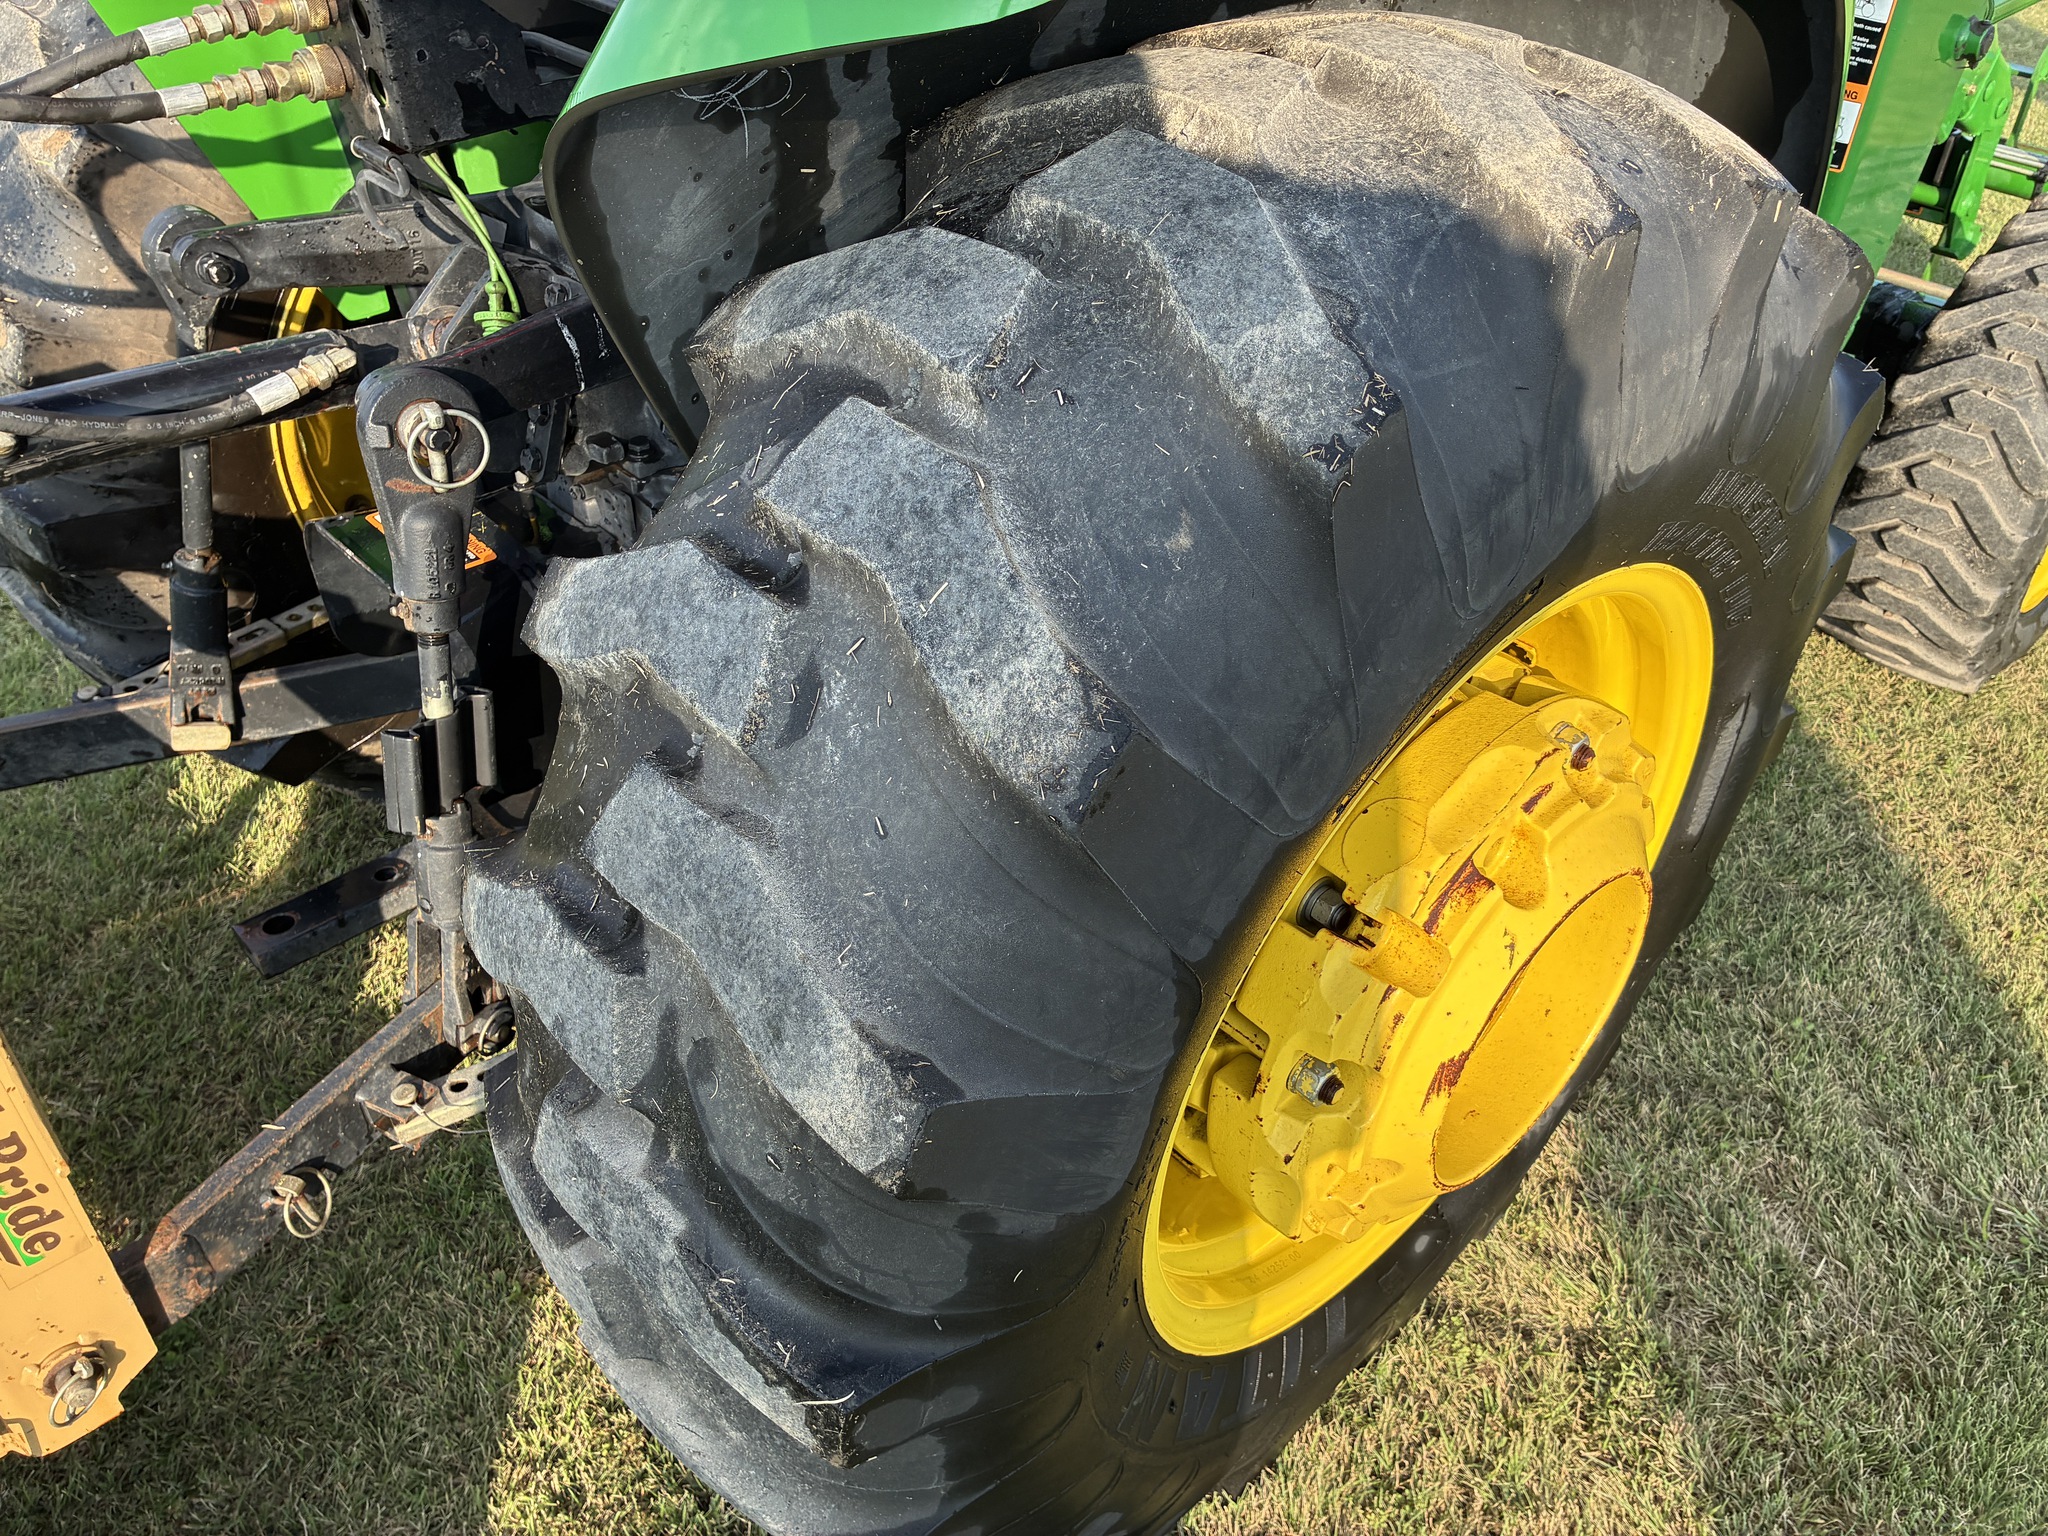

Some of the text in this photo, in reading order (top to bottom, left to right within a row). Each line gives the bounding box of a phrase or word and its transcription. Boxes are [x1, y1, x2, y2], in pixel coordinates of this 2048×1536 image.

[1639, 520, 1753, 630] TRACTOR LUG
[1693, 468, 1790, 580] INDUSTRIAL
[0, 1130, 65, 1256] Pride
